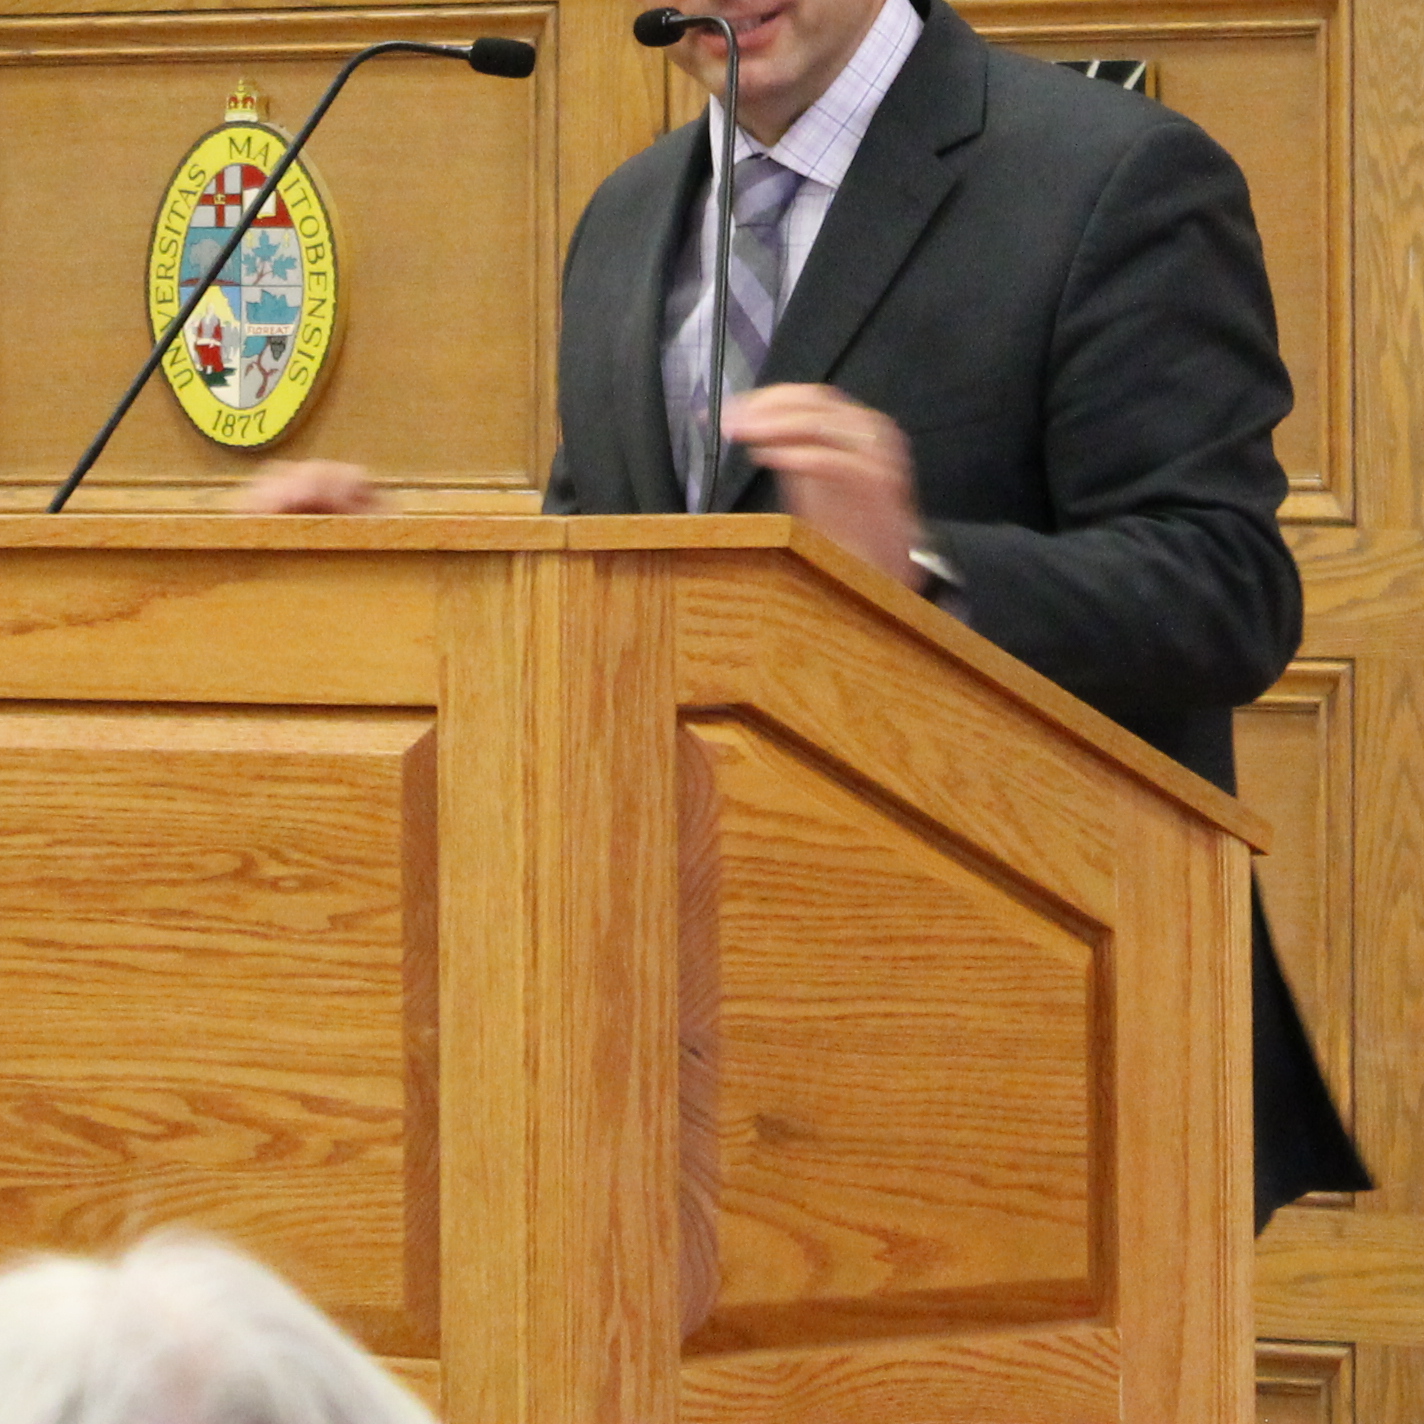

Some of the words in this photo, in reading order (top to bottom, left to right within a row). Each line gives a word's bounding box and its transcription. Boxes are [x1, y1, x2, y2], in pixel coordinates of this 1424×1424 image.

[155, 164, 206, 390] UNVERSITAS
[228, 136, 332, 386] MAITOBENSIS
[246, 325, 291, 335] FLOREAT
[212, 409, 267, 438] 1877
